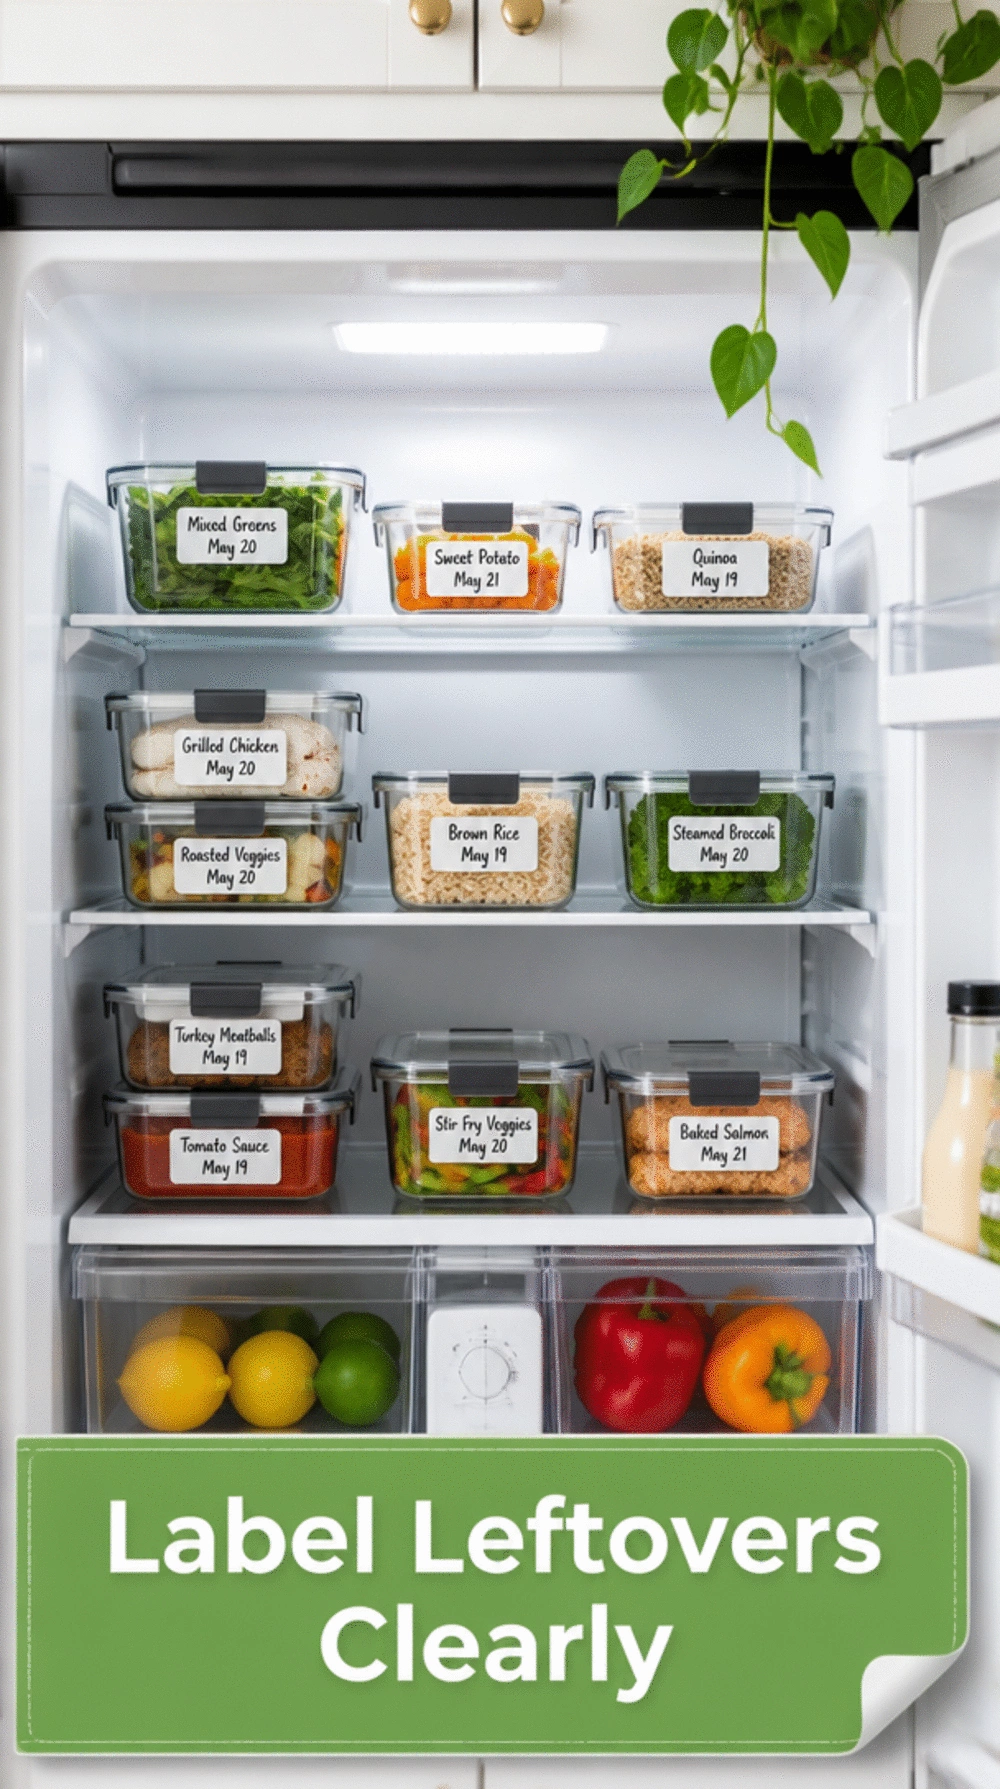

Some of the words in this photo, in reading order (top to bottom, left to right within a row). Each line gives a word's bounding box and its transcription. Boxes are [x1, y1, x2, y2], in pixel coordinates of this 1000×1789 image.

[232, 515, 277, 532] Greens
[208, 539, 235, 562] May
[239, 538, 257, 554] 20
[435, 548, 474, 566] Sweet
[480, 548, 521, 566] Potato
[692, 547, 738, 567] Quinoa
[454, 571, 482, 594] May
[486, 571, 500, 587] 21
[691, 571, 720, 594] May
[725, 571, 738, 587] 19
[182, 736, 224, 754] Grilled
[229, 736, 279, 754] Chicken
[206, 760, 235, 782] May
[238, 760, 256, 776] 20
[448, 823, 488, 841] Brown
[493, 823, 520, 841] Rice
[672, 823, 725, 841] Steamed
[181, 846, 230, 863] Roasted
[234, 846, 281, 869] Veggies
[461, 846, 490, 869] May
[494, 846, 508, 863] 19
[700, 846, 728, 869] May
[732, 846, 749, 862] 20
[206, 868, 235, 891] May
[239, 869, 256, 885] 20
[174, 1026, 216, 1049] Turkey
[219, 1026, 277, 1043] Meatballs
[202, 1049, 230, 1072] May
[235, 1049, 248, 1066] 19
[435, 1115, 458, 1132] Stir
[462, 1114, 483, 1137] Fry
[486, 1114, 532, 1138] Veggies
[680, 1122, 719, 1140] Baked
[723, 1122, 769, 1140] Salmon
[180, 1136, 227, 1153] Tomato
[232, 1136, 270, 1154] Sauce
[458, 1137, 487, 1161] May
[491, 1138, 508, 1154] 20
[701, 1146, 728, 1168] May
[732, 1146, 747, 1162] 21
[201, 1159, 231, 1182] May
[235, 1159, 248, 1175] 19
